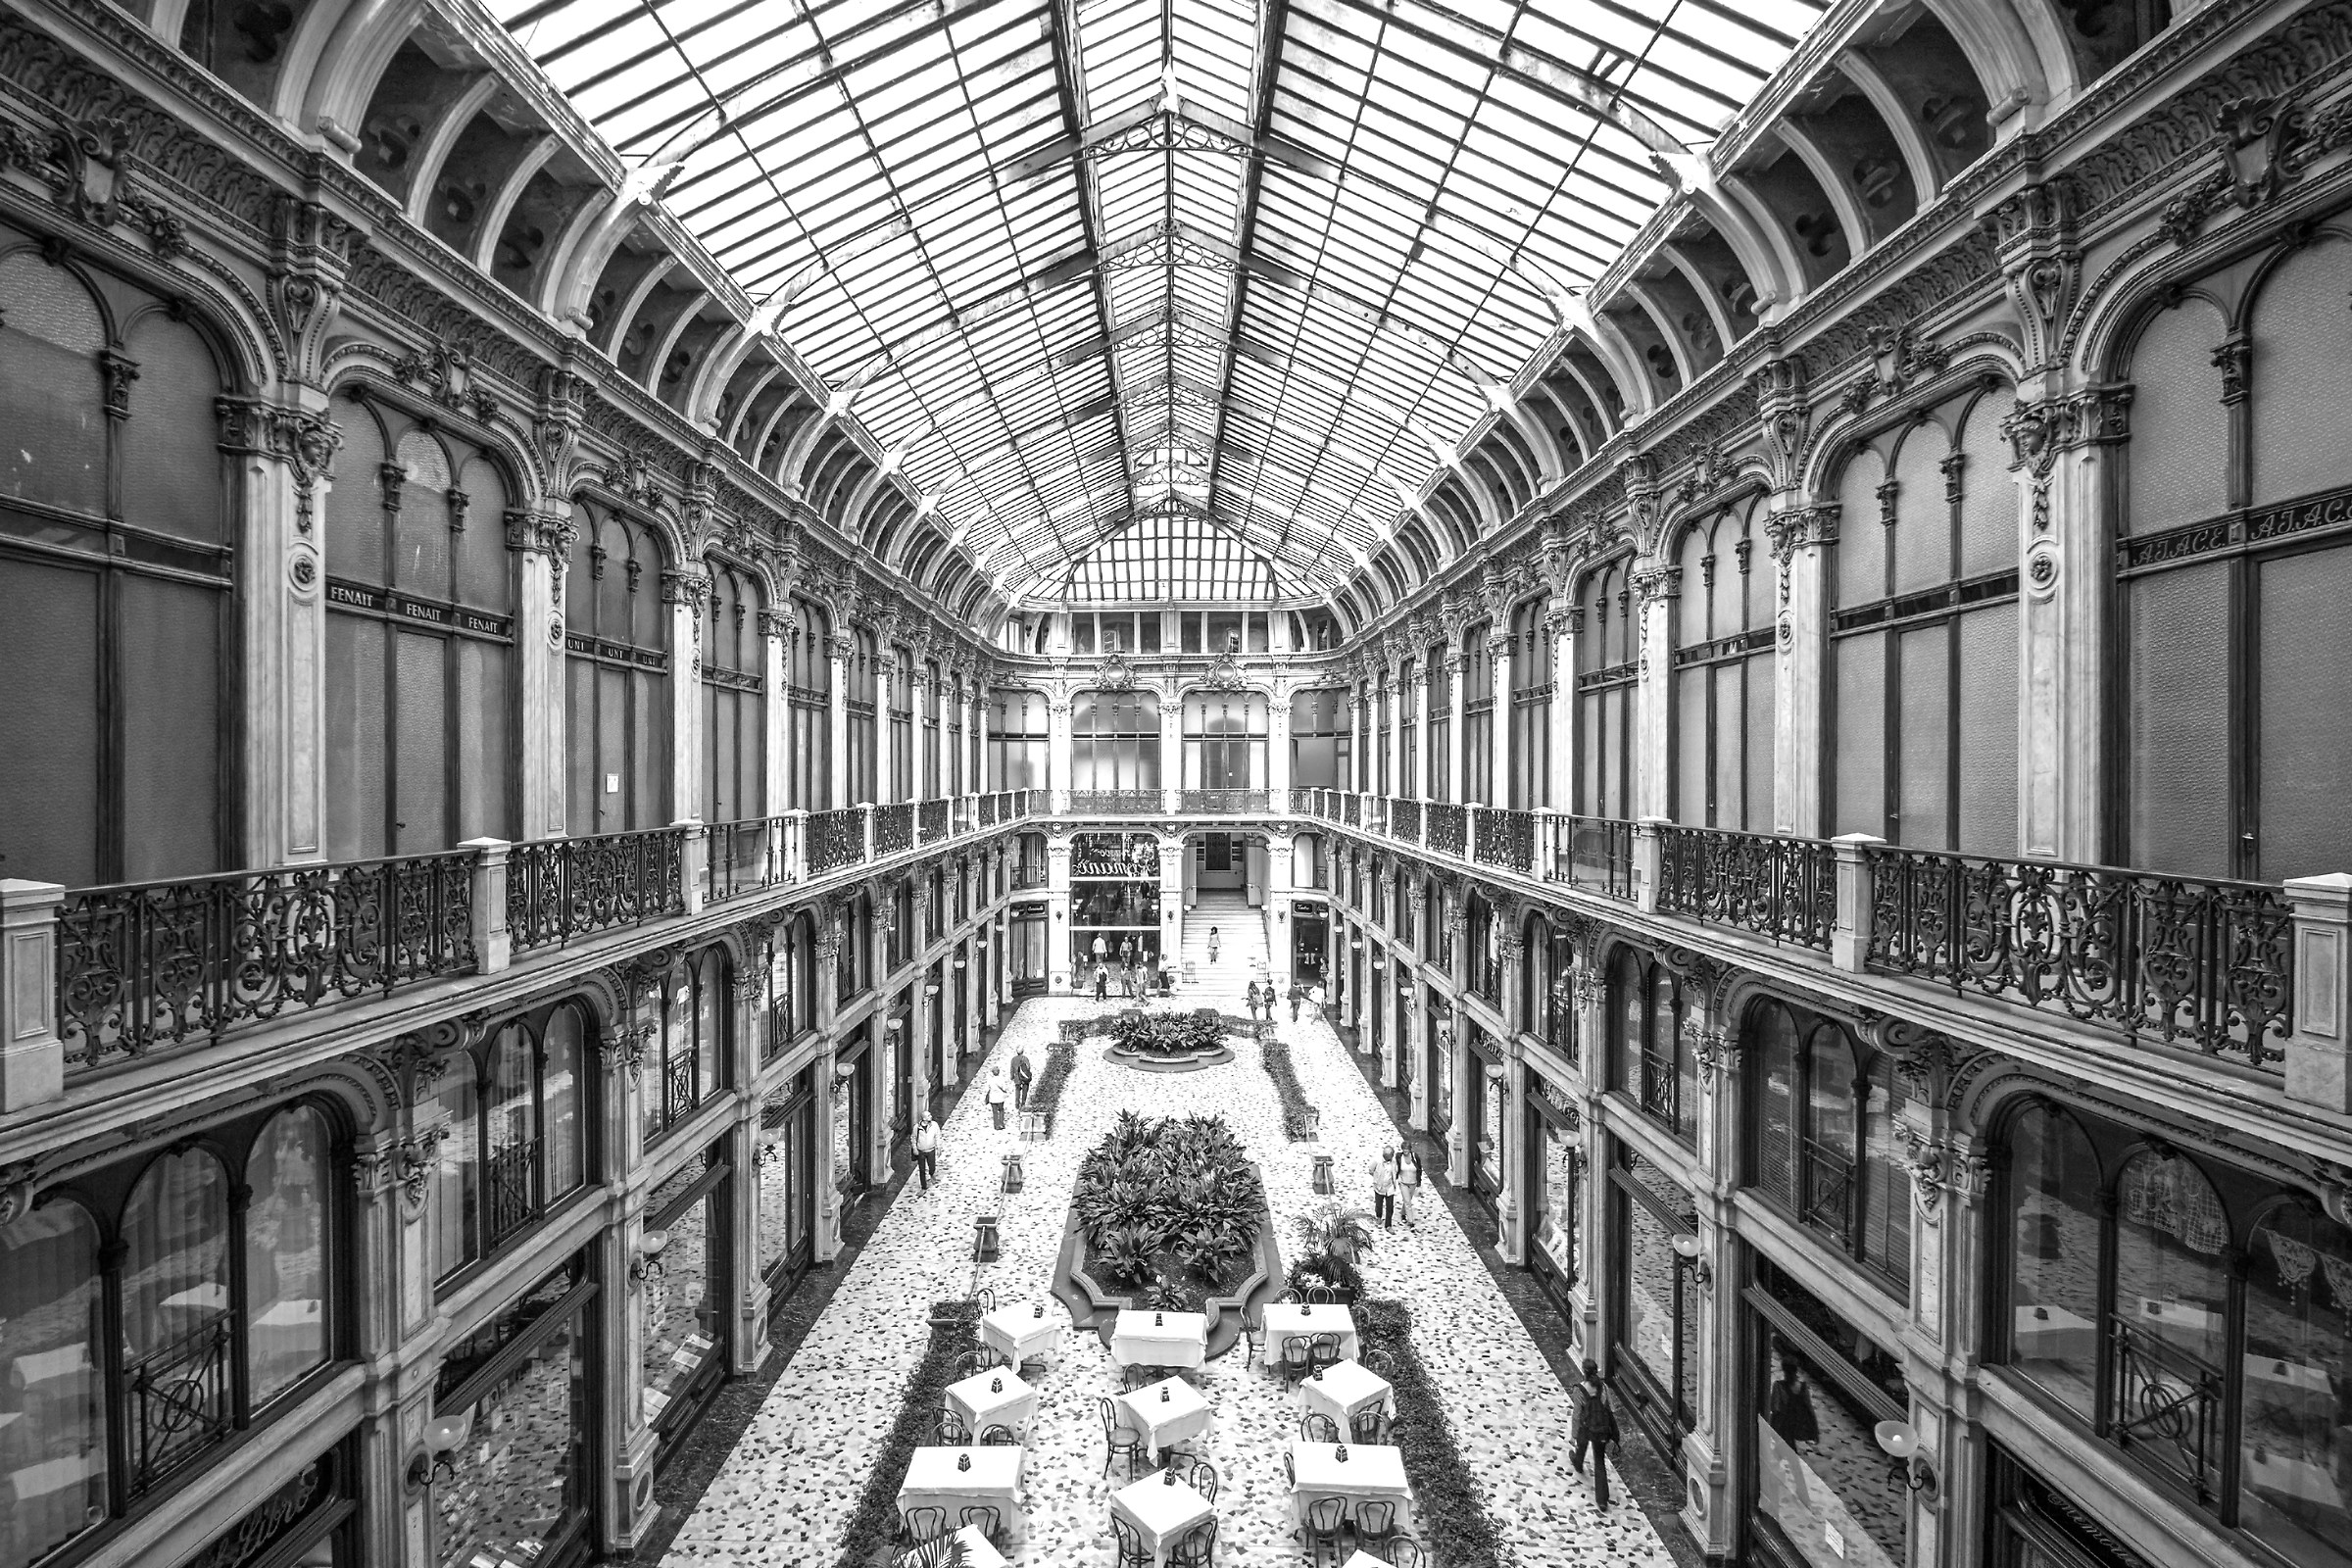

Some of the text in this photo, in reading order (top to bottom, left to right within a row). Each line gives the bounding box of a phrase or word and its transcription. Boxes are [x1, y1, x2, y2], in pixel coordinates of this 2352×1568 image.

[330, 586, 373, 608] FENAIT
[407, 603, 441, 621] FENAIT
[468, 616, 498, 633] FENAIT
[567, 639, 584, 651] UNI
[608, 648, 623, 659] UNI
[642, 656, 657, 665] UNI
